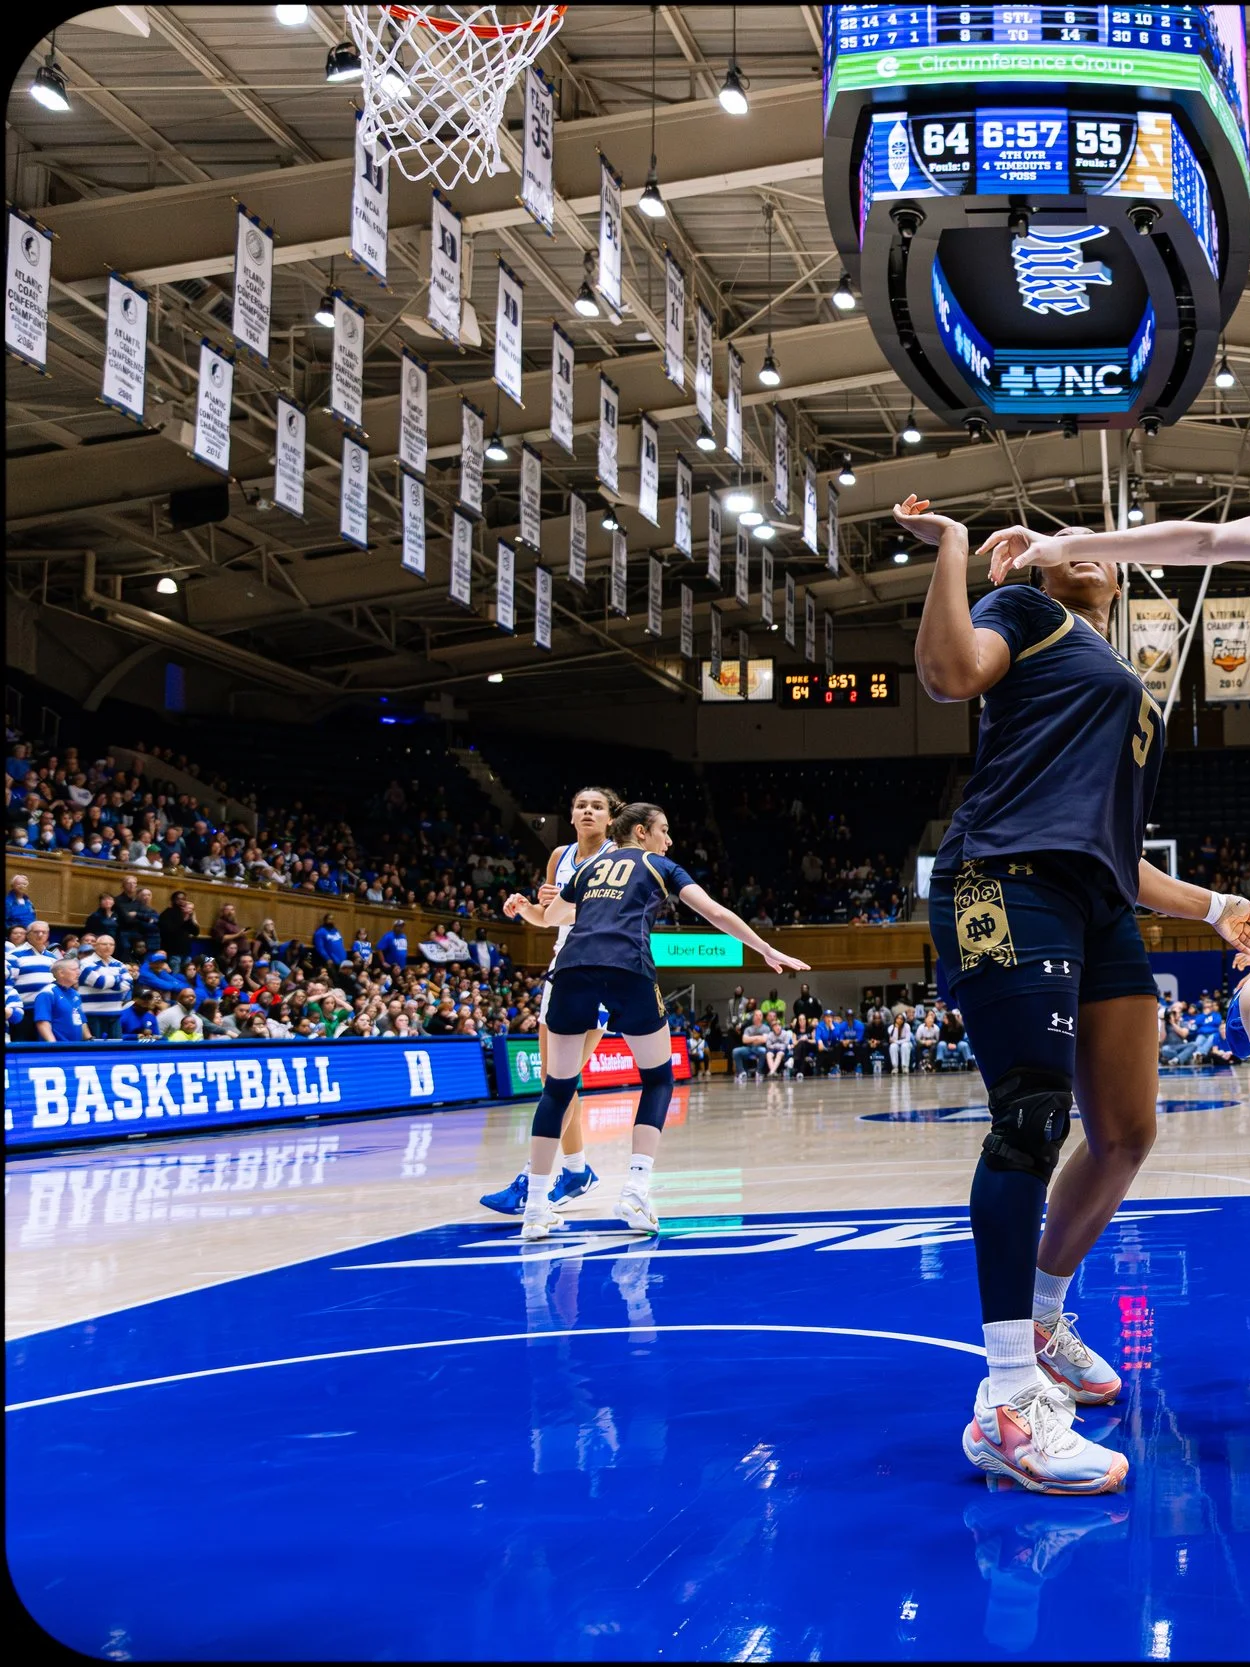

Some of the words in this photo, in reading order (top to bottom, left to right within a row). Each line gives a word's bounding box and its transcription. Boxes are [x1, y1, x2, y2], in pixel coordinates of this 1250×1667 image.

[840, 17, 857, 30] 22
[862, 15, 880, 28] 14
[887, 13, 897, 25] 4
[910, 12, 919, 24] 1
[1003, 12, 1033, 24] STL
[1112, 12, 1131, 24] 23
[1134, 13, 1153, 26] 10
[1161, 15, 1171, 27] 2
[1183, 18, 1192, 30] 1
[840, 36, 858, 49] 35
[862, 34, 880, 47] 17
[887, 32, 898, 45] 7
[910, 31, 920, 43] 1
[1008, 29, 1029, 41] TO
[1061, 29, 1080, 41] 14
[1112, 30, 1132, 42] 30
[1183, 36, 1193, 48] 1
[918, 53, 1067, 72] Circumference
[1071, 54, 1135, 76] Group
[923, 122, 970, 157] 64
[982, 121, 1063, 148] 6:57
[1076, 122, 1121, 155] 55
[998, 150, 1022, 160] 4TH
[1023, 150, 1046, 161] QTR
[1075, 157, 1108, 168] Fouls:
[1108, 158, 1117, 168] 2
[928, 162, 962, 173] Fouls:
[982, 161, 990, 170] 4
[994, 161, 1051, 170] TIMEOUTS
[1055, 161, 1063, 170] 2
[1009, 171, 1037, 181] POSS
[15, 268, 42, 293] ATLANTIC
[18, 283, 39, 302] COAST
[8, 288, 48, 320] CONFERENCE
[1065, 364, 1123, 394] NC
[785, 675, 809, 684] DUKE
[792, 686, 809, 700] 64
[849, 691, 857, 702] 2
[871, 684, 888, 698] 55
[587, 858, 636, 887] 30
[583, 888, 625, 901] SANCHEZ
[667, 944, 695, 956] Uber
[698, 944, 726, 956] Eats
[28, 1056, 341, 1129] BASKETBALL
